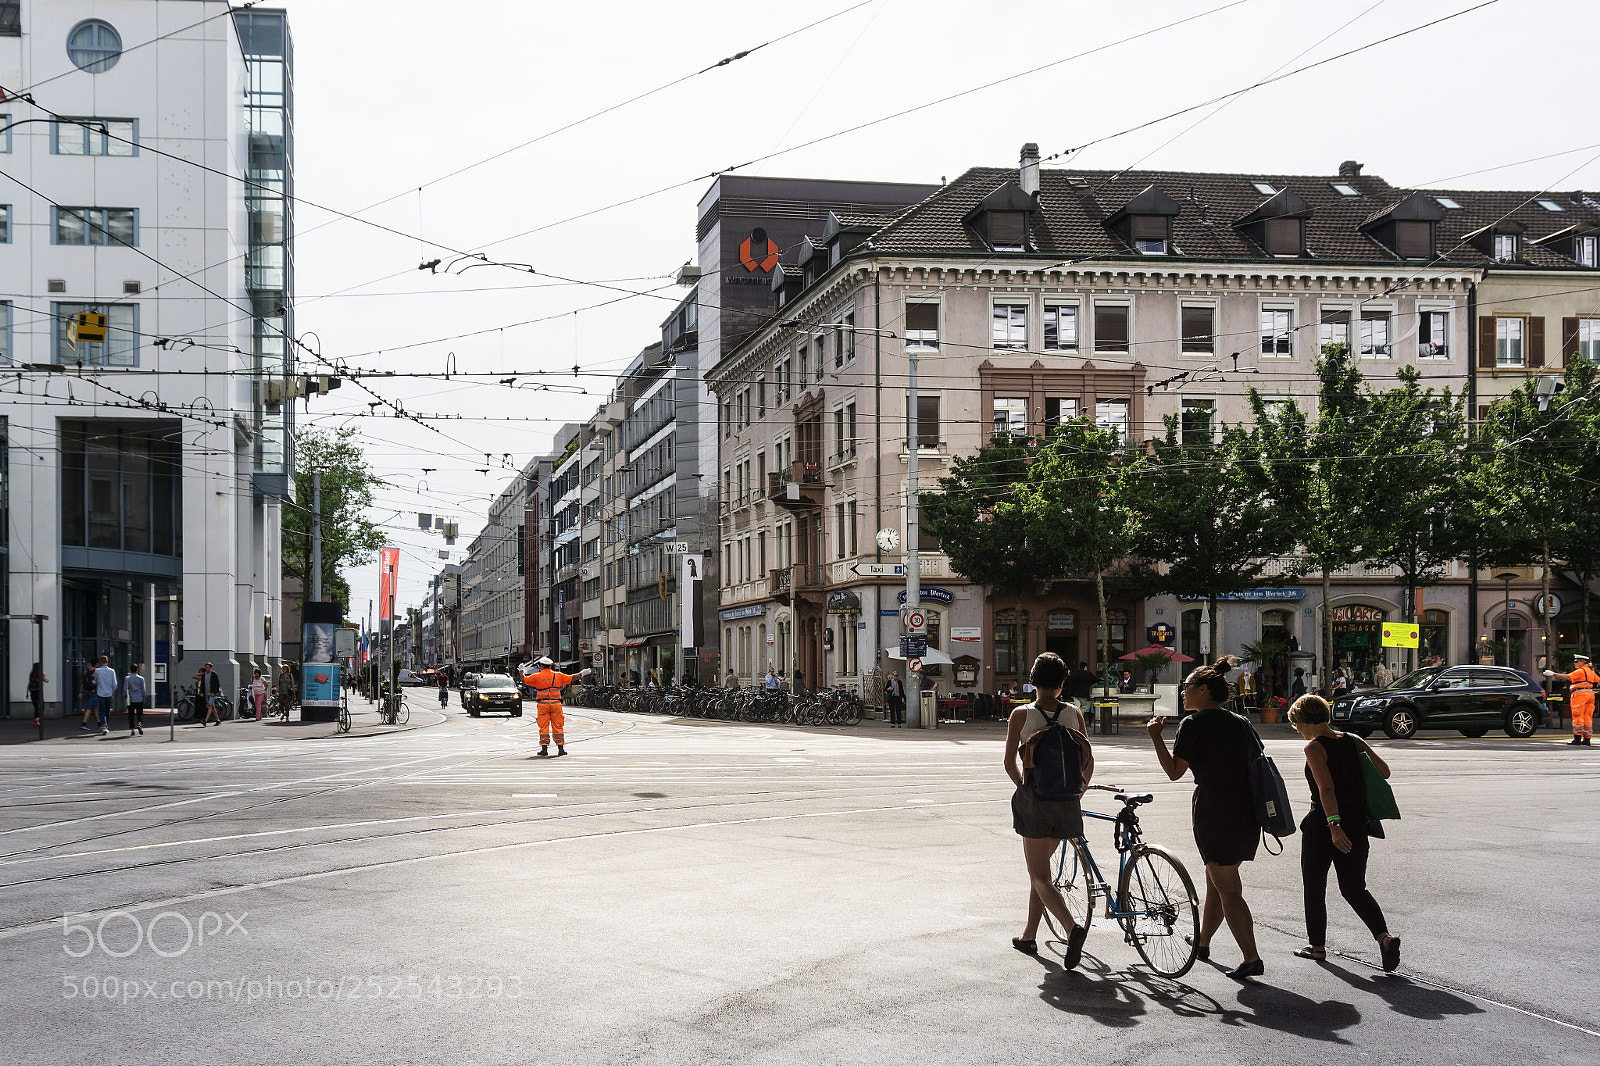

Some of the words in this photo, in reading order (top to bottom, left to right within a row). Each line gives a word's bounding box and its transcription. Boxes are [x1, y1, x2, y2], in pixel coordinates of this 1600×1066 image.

[666, 544, 674, 552] W
[677, 544, 687, 552] 25
[870, 565, 884, 573] Taxi
